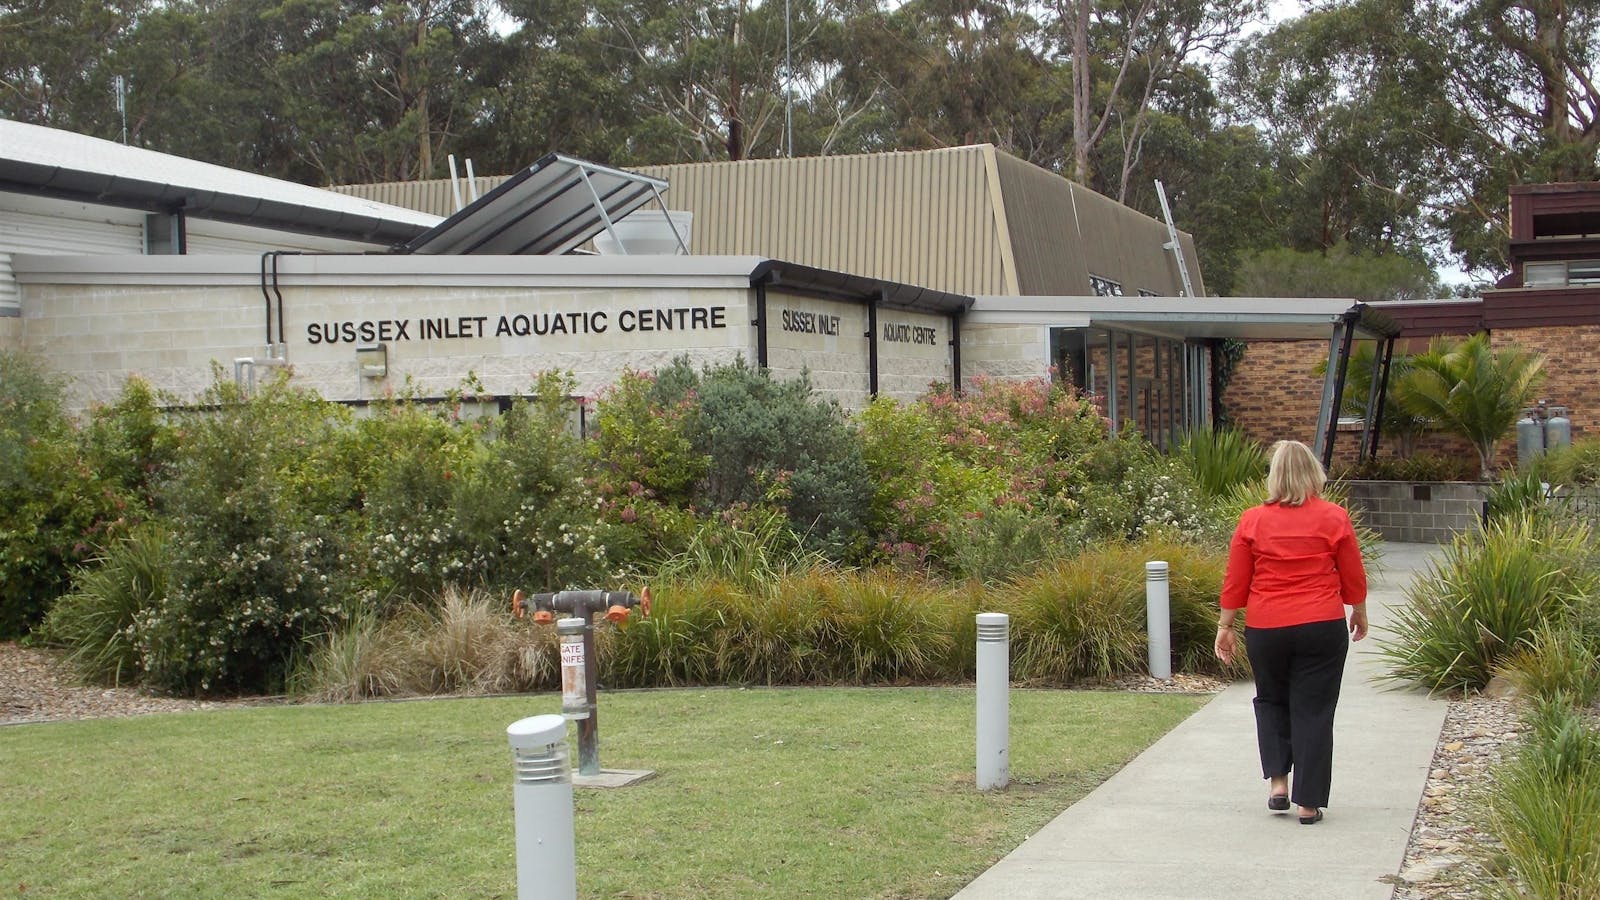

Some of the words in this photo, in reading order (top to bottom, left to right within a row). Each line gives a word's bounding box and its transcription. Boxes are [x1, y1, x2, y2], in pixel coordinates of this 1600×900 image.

[307, 319, 410, 345] SUSSEX
[419, 315, 488, 340] INLET
[495, 310, 609, 337] AQUATIC
[618, 306, 727, 332] CENTRE
[782, 308, 816, 334] SUSSEX
[818, 315, 841, 337] INLET
[883, 322, 911, 344] AQUATIC
[912, 325, 937, 346] CENTRE
